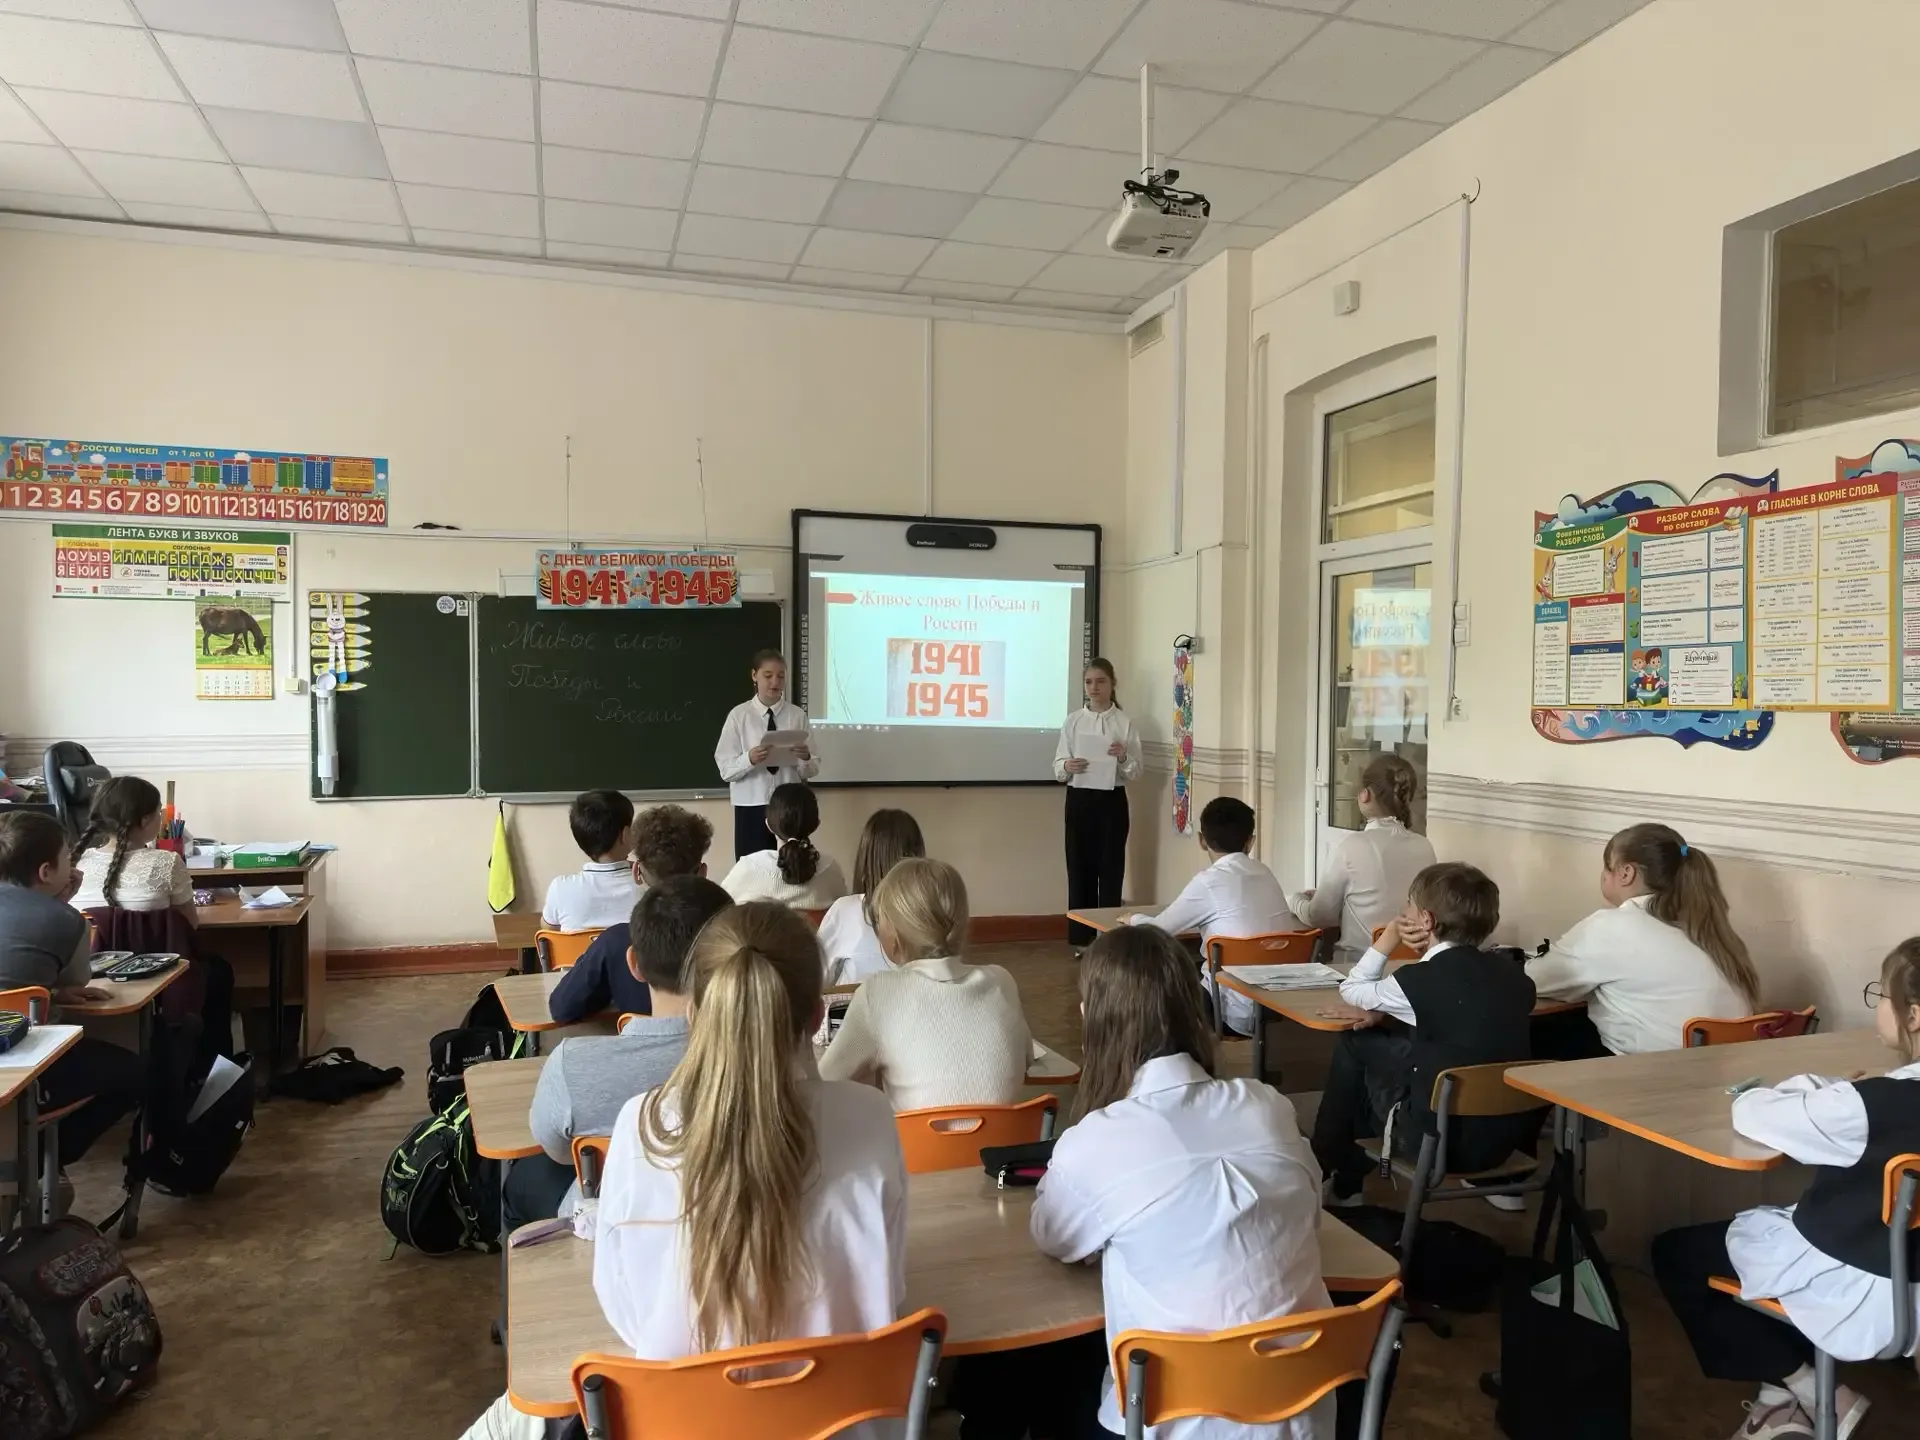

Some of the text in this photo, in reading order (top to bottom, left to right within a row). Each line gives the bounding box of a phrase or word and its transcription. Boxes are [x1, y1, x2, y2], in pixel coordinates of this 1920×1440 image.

[82, 443, 122, 454] СОСТАВ
[125, 446, 159, 455] ЧИСЕЛ
[10, 486, 386, 523] 1 2 3 4 5 6 7 8 9 10 11 12 13 14 15 16 17 18 19 20
[1770, 483, 1880, 510] ГЛАСНЫЕ В КОРНЕ СЛОВА
[1656, 506, 1720, 524] РАЗБОР СЛОВА
[1555, 525, 1604, 539] Фонетический
[1676, 518, 1710, 530] составу
[107, 527, 239, 541] ЛЕНТА БУКВ И ЗВУКОВ
[1555, 532, 1606, 547] РАЗБОР СЛОВА
[539, 553, 735, 567] С ДНЕМ ВЕЛИКОЙ ПОБЕДЫ!
[550, 569, 732, 606] 1941 1945
[859, 590, 1040, 612] Живое слово Победы и
[923, 615, 978, 632] России
[910, 641, 982, 677] 1941
[906, 682, 989, 718] 1945
